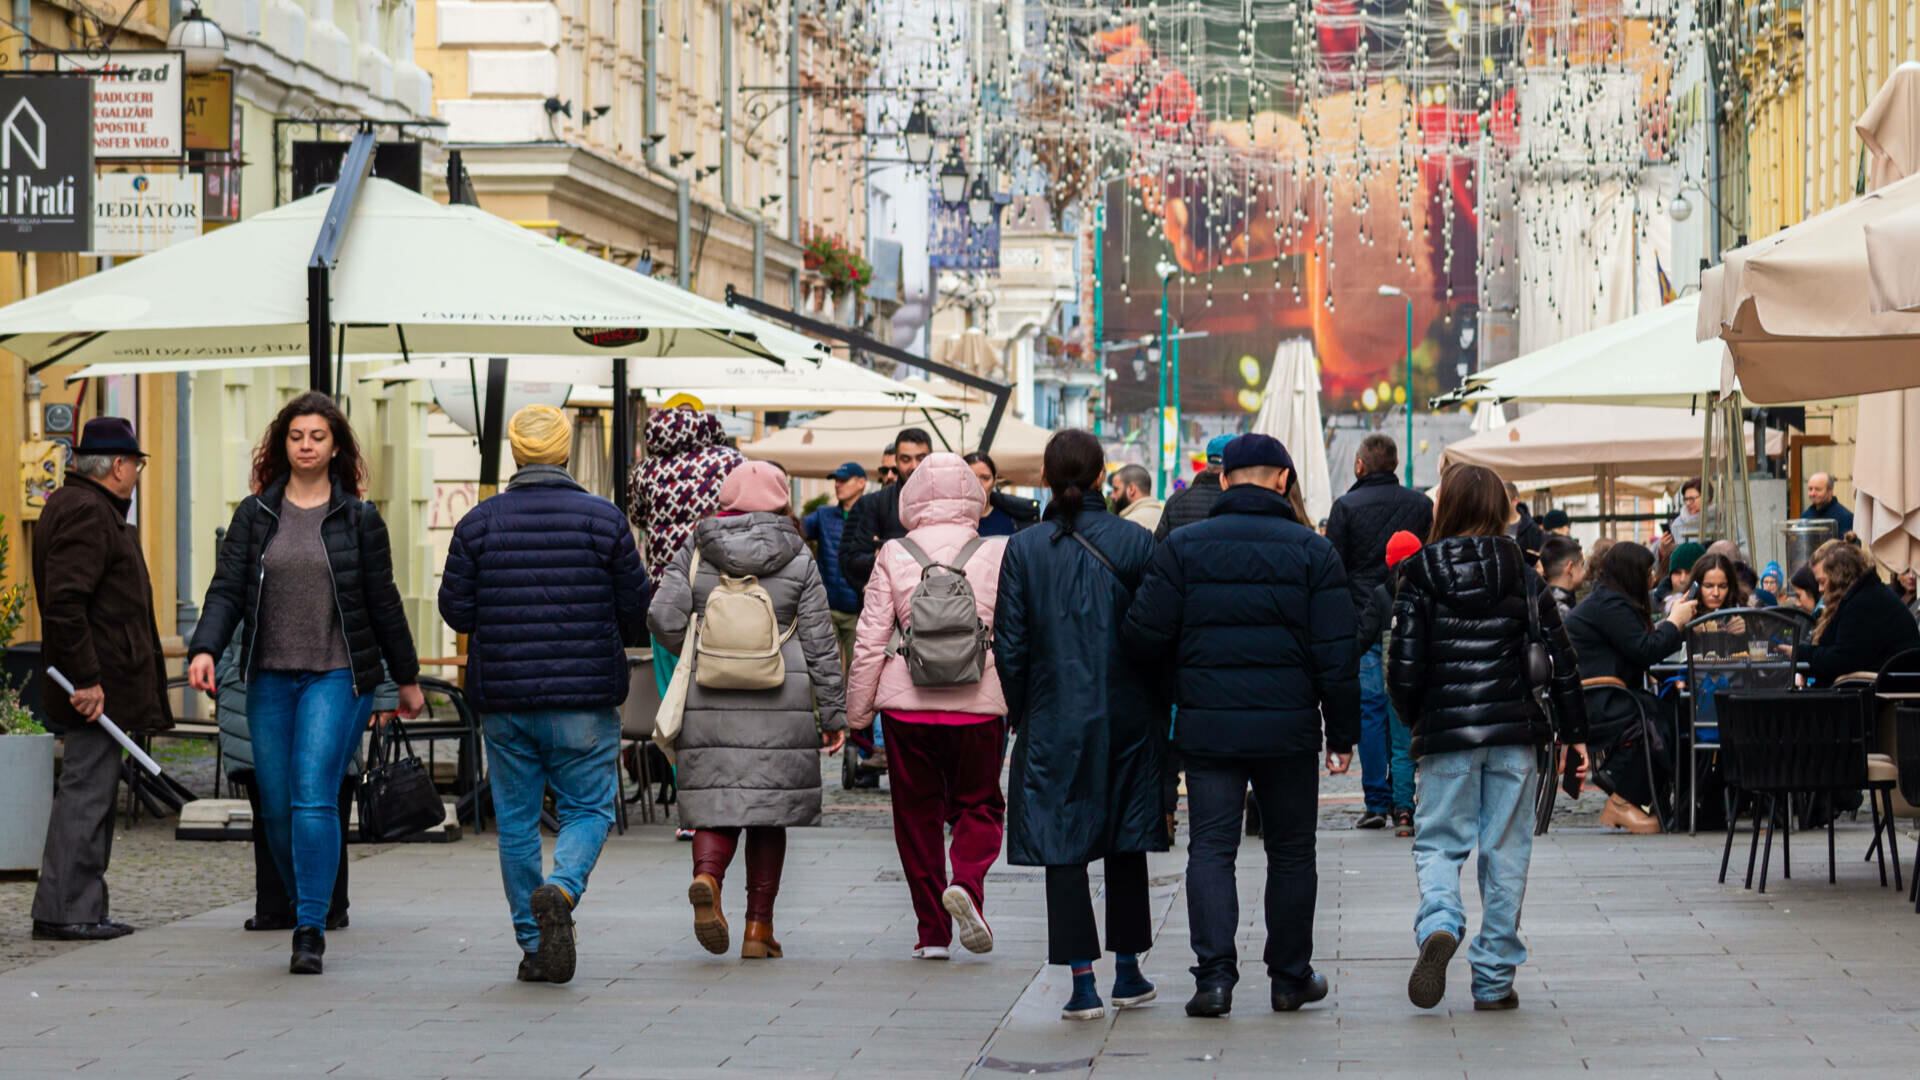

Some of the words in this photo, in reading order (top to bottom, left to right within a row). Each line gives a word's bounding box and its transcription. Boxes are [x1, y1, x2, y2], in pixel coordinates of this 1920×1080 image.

[94, 92, 154, 103] RADUCERI
[185, 97, 208, 116] AT
[94, 137, 131, 148] NSFER
[133, 137, 170, 148] VIDEO
[16, 175, 75, 215] Frati
